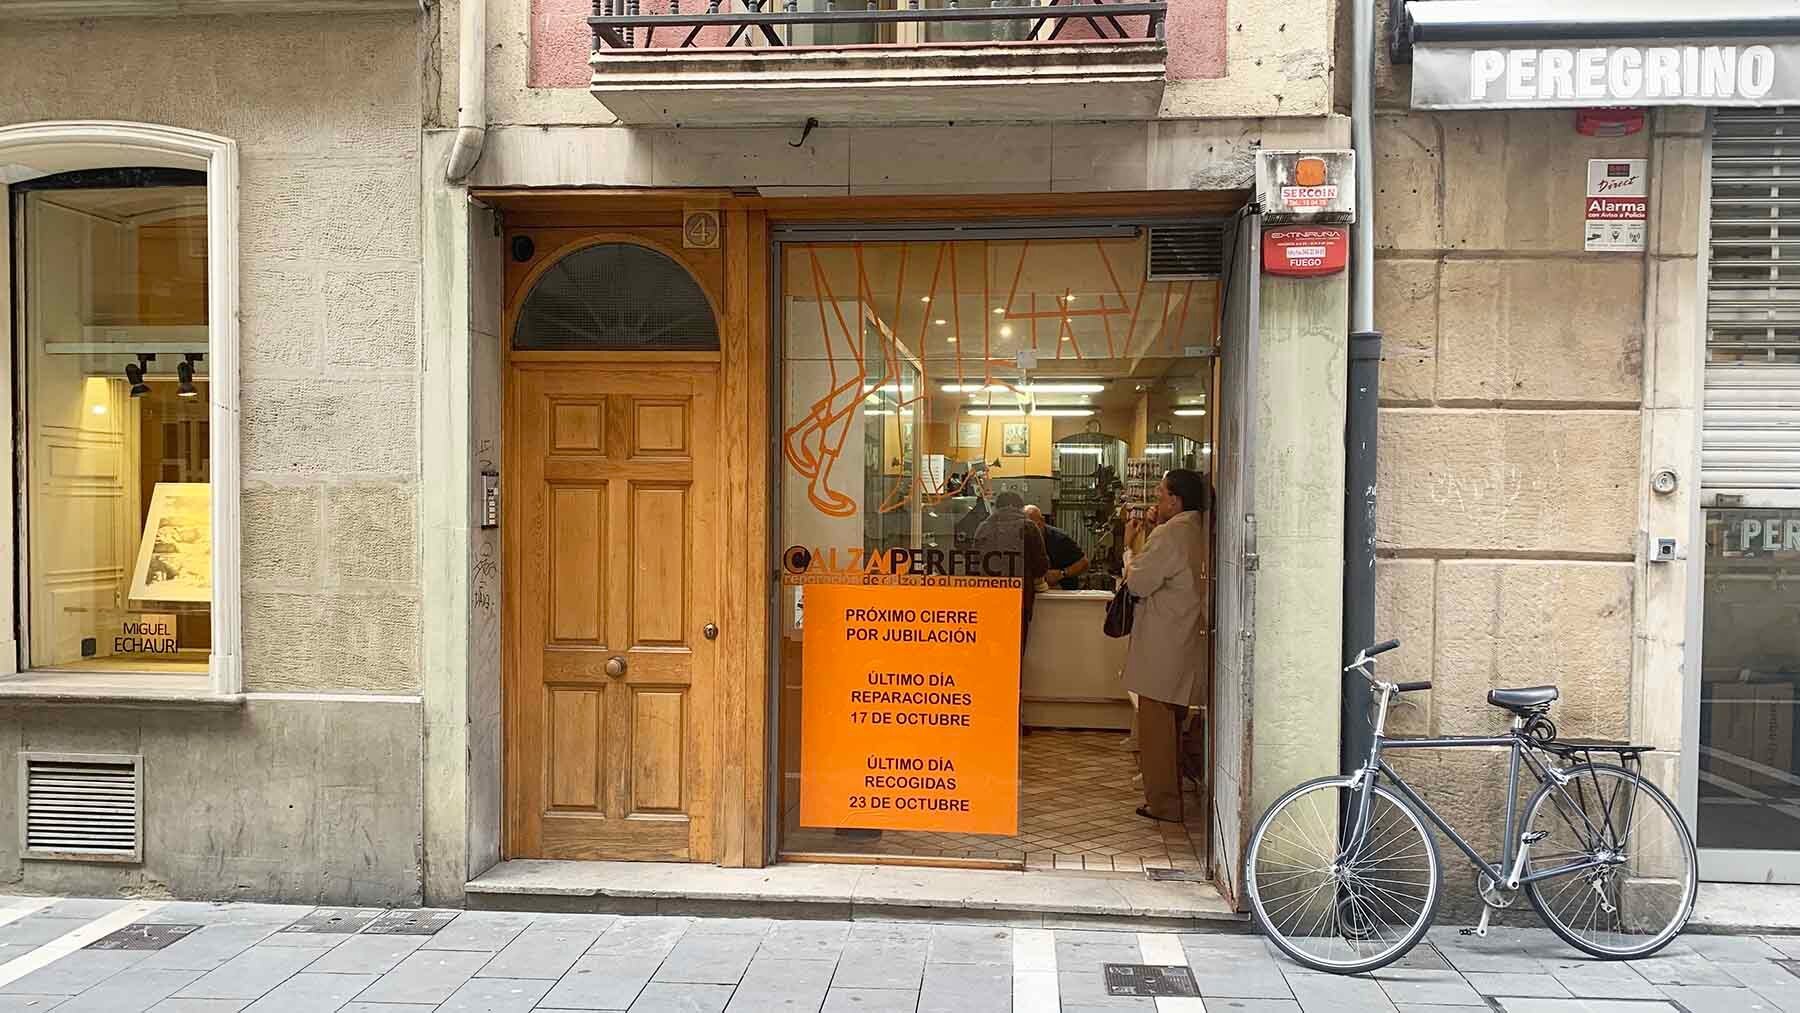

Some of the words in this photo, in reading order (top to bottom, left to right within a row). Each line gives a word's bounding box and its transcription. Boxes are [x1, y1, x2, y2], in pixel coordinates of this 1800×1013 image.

[1470, 45, 1776, 100] PEREGRINO
[1283, 188, 1336, 198] SERCOIN
[1589, 200, 1646, 212] Alarma
[690, 216, 709, 241] 4
[1290, 258, 1322, 267] FUEGO
[784, 545, 1021, 578] CALZAPERFECT
[953, 576, 1021, 589] momento
[845, 606, 916, 623] PRÓXIMO
[920, 609, 978, 624] CIERRE
[123, 623, 171, 636] MIGUEL
[846, 628, 879, 641] POR
[882, 627, 977, 644] JUBILACIÓN
[114, 637, 179, 653] ECHAURI
[868, 670, 925, 687] ÚLTIMO
[928, 672, 956, 688] DÍA
[851, 690, 972, 706] REPARACIONES
[850, 711, 868, 724] 17
[871, 712, 892, 725] DE
[895, 712, 971, 727] OCTUBRE
[867, 754, 924, 771] ÚLTIMO
[928, 757, 955, 772] DÍA
[864, 775, 957, 791] RECOGIDAS
[849, 796, 867, 809] 23
[870, 797, 891, 809] DE
[895, 797, 970, 812] OCTUBRE
